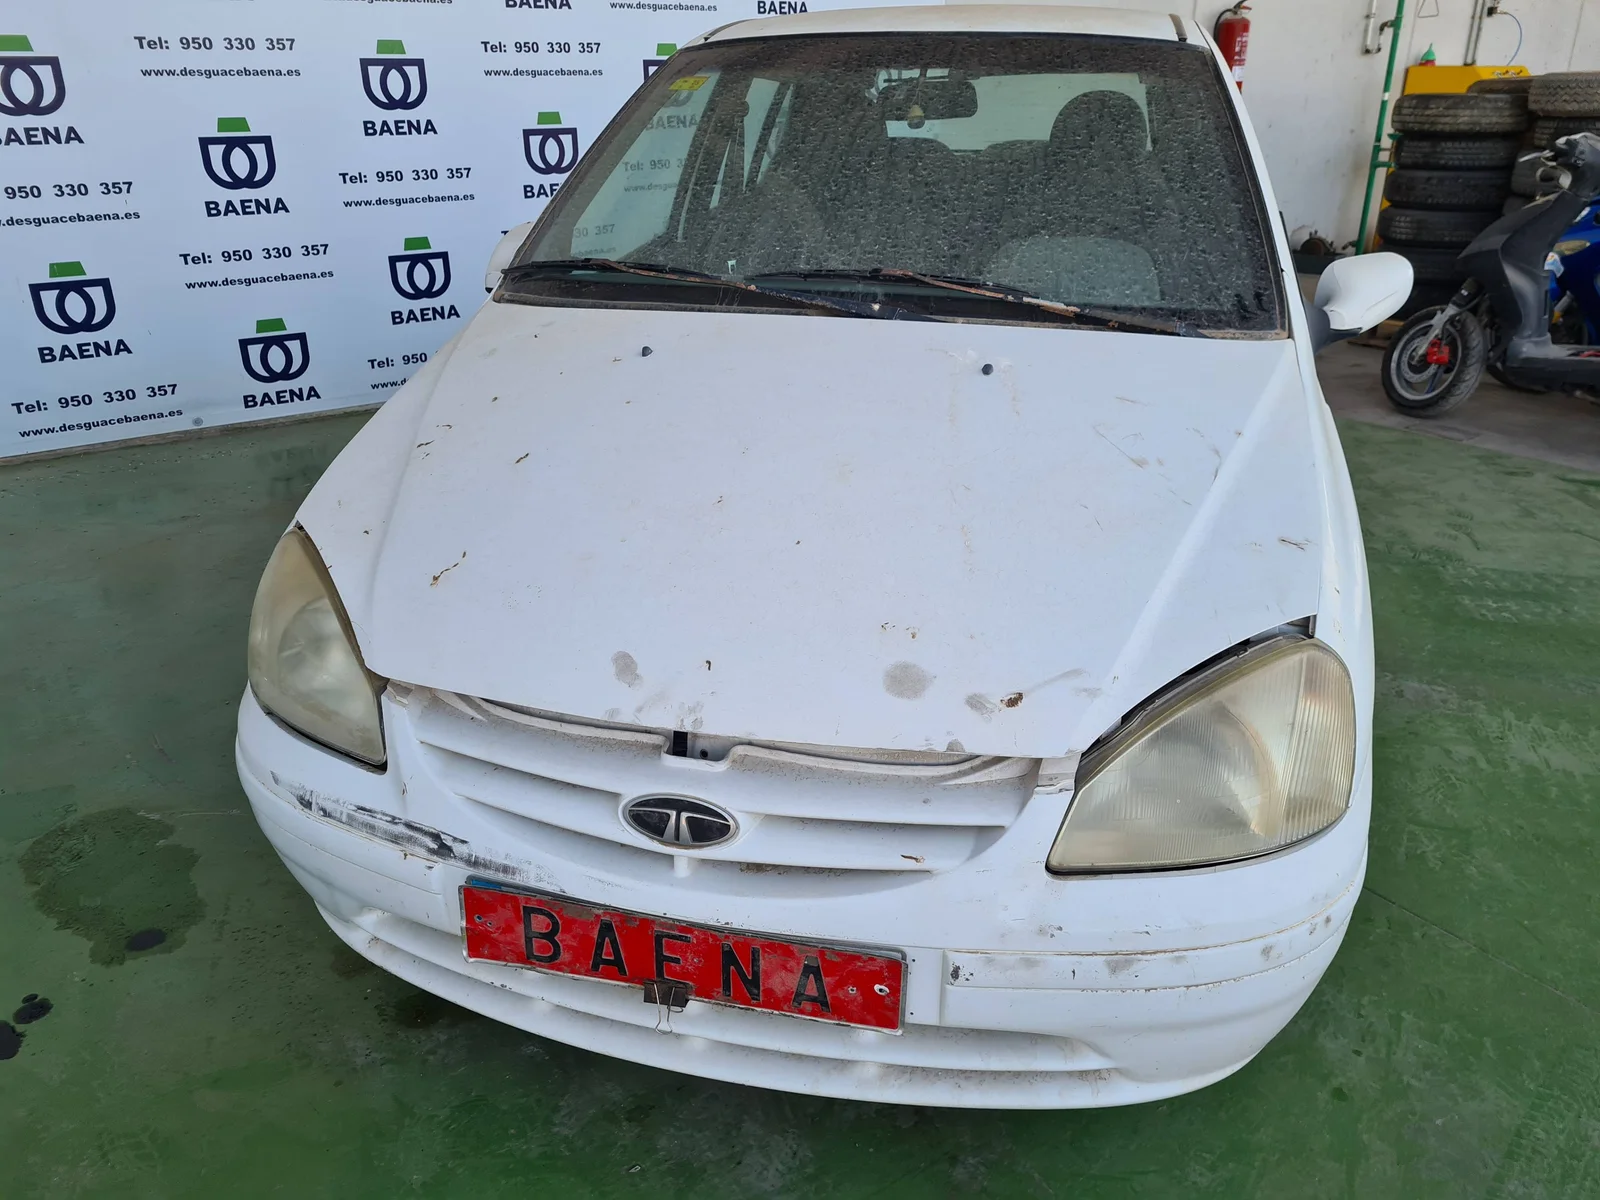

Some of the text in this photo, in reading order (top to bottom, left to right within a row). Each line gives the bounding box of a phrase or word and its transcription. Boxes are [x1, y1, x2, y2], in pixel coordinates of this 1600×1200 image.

[610, 1, 717, 12] www.desguacebaena.es
[757, 0, 808, 15] BAENA
[134, 37, 295, 50] Tel: 950 330 357
[481, 42, 600, 53] Tel: 950 330 357
[141, 67, 300, 78] www.desguacebaena.es
[484, 68, 603, 78] www.desguacebaena.es
[363, 119, 438, 136] BAENA
[0, 126, 84, 146] AENA
[622, 160, 644, 172] Tel:
[649, 159, 671, 170] 950
[339, 168, 471, 184] Tel: 950 330 357
[4, 182, 132, 199] 950 330 357
[523, 183, 560, 199] BAE
[205, 198, 290, 217] BAENA
[343, 194, 474, 207] www.desguacebaena.es
[0, 212, 140, 227] .desguacebaena.es
[574, 224, 615, 238] 30 357
[179, 244, 328, 265] Tel: 950 330 357
[185, 271, 333, 289] www.desguacebaena.es
[391, 305, 460, 325] BAENA
[38, 339, 132, 363] BAENA
[368, 353, 427, 369] Tel: 950
[370, 377, 407, 390] www.d
[11, 384, 177, 414] Tel: 950 330 357
[243, 386, 321, 408] BAENA
[19, 408, 183, 438] www.desguacebaena.es
[522, 905, 832, 1014] BAENA
